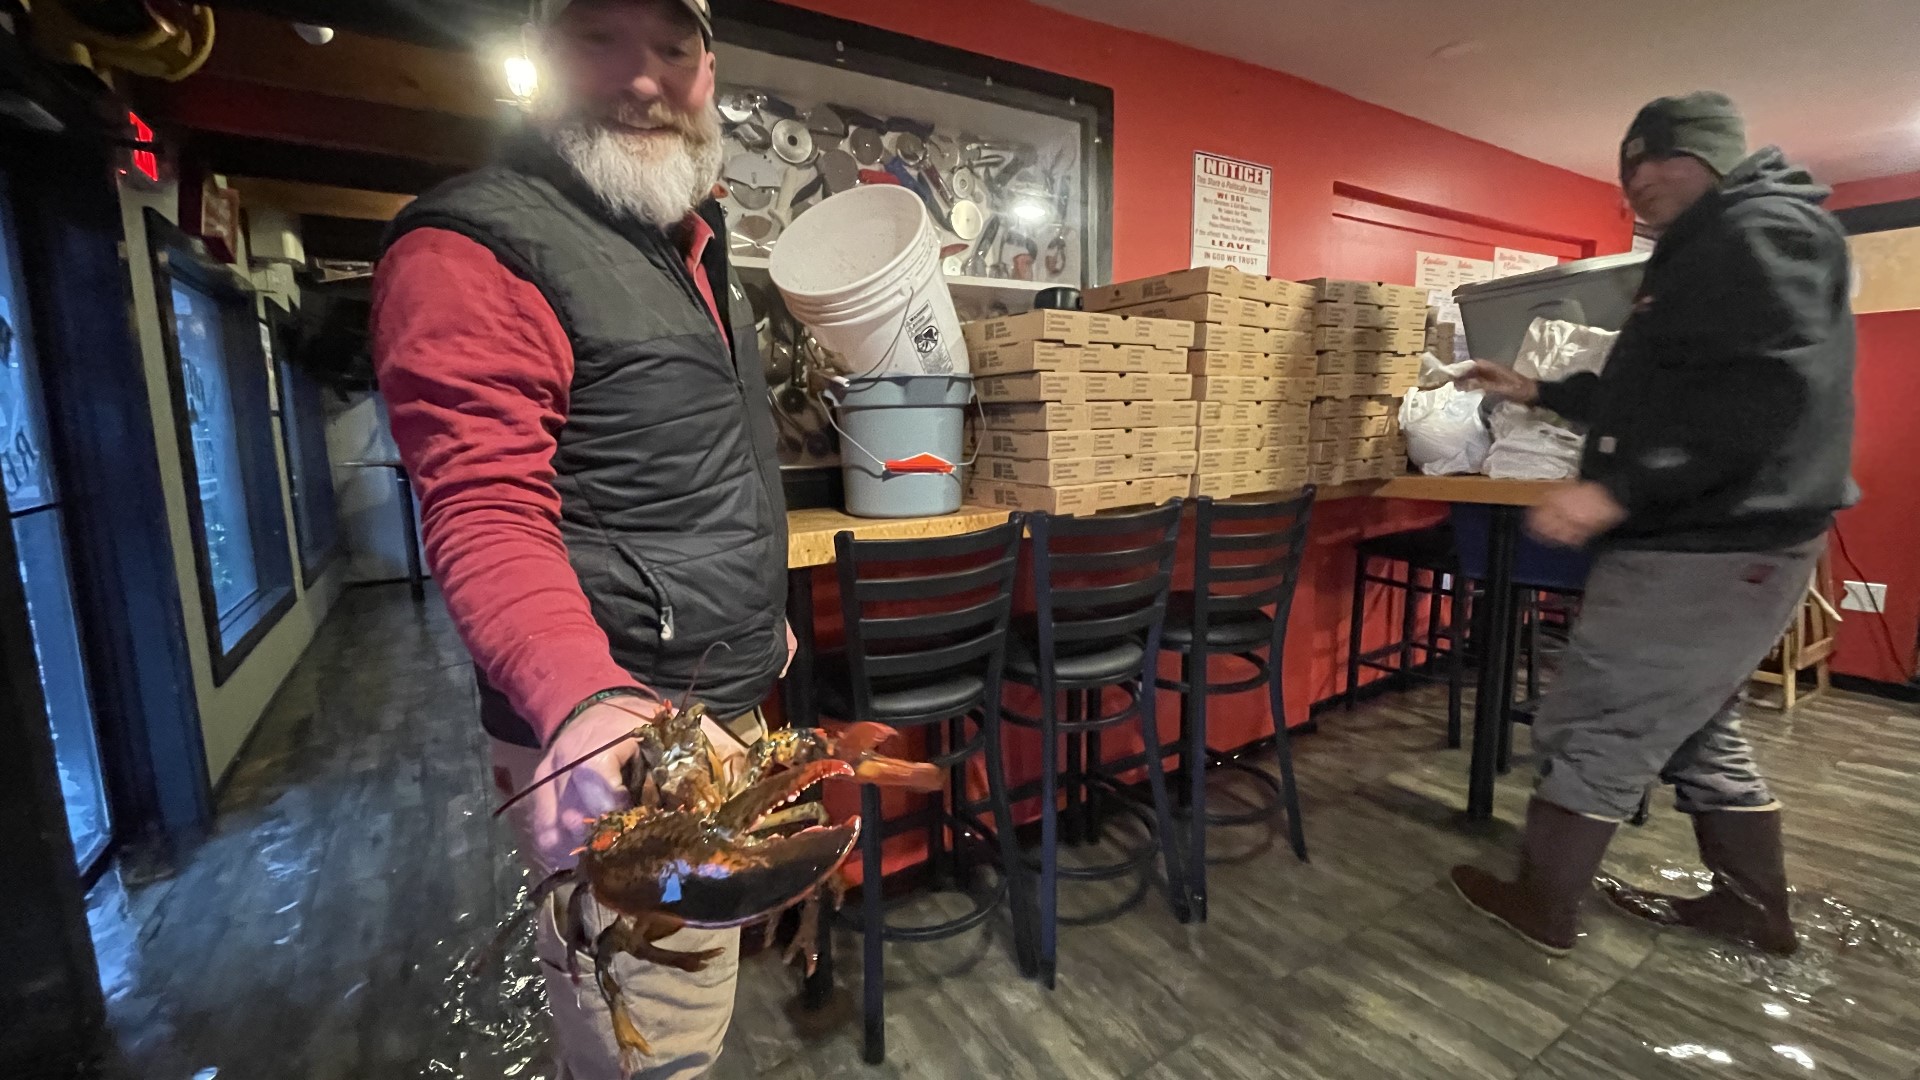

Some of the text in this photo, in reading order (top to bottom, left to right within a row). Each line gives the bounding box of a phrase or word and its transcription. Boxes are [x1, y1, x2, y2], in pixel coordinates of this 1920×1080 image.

[1205, 158, 1262, 185] NOTICE
[1211, 239, 1251, 251] LEAVE
[1212, 253, 1225, 262] GOD
[1226, 255, 1237, 263] WE
[1239, 256, 1258, 265] TRUST
